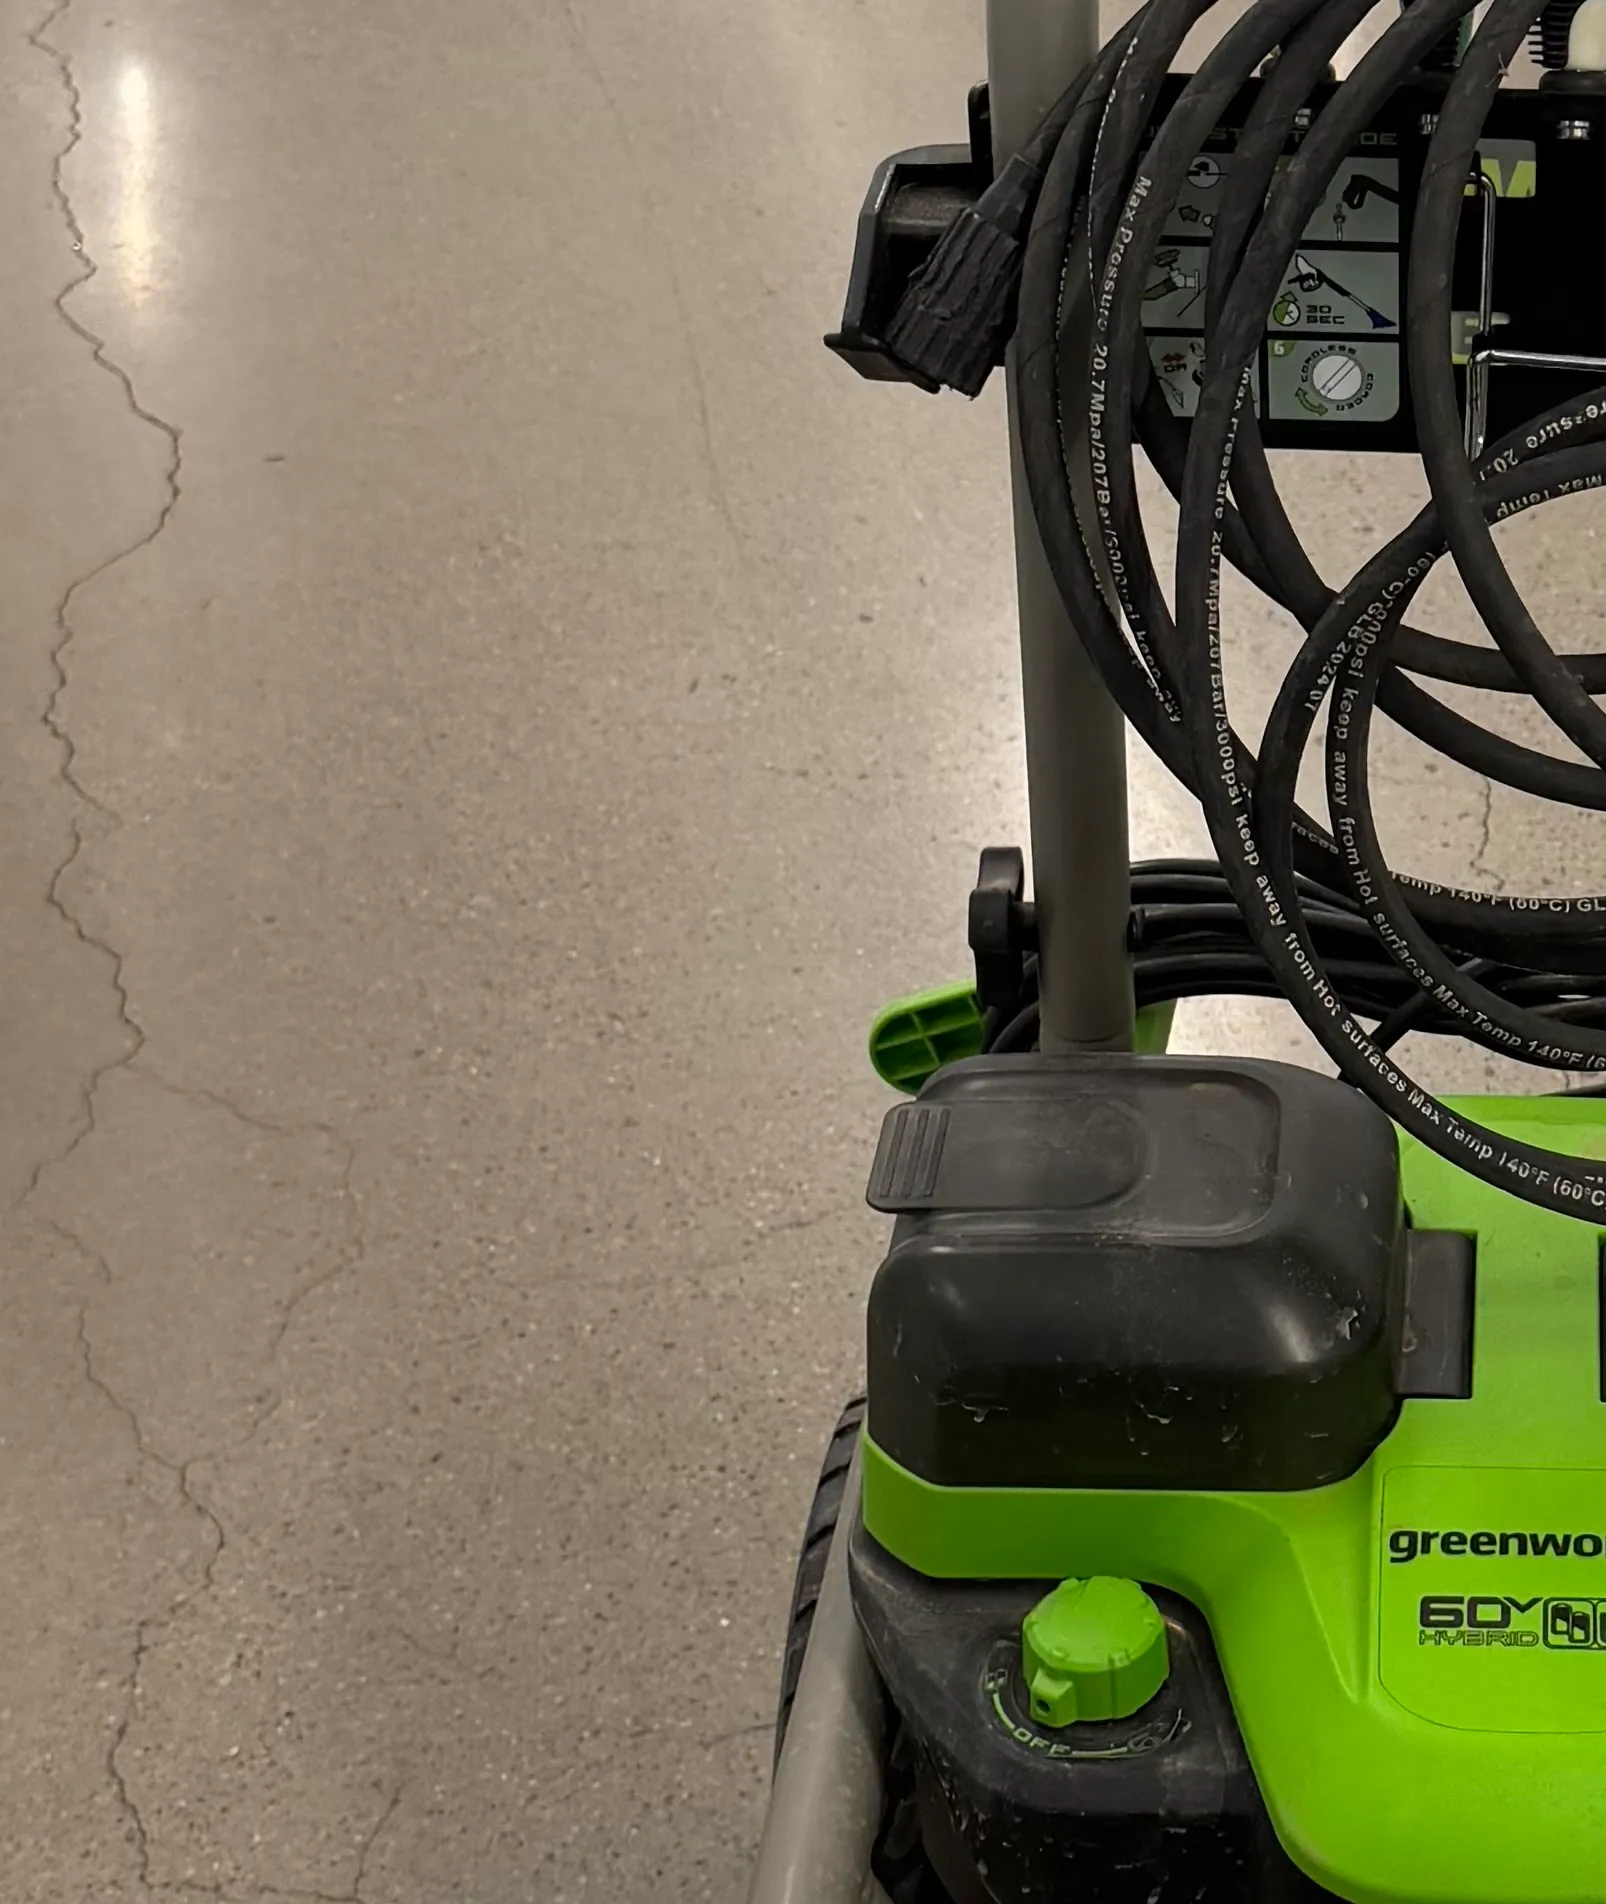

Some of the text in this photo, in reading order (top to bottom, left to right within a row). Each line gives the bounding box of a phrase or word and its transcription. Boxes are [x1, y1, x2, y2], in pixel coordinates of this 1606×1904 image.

[1125, 176, 1152, 222] Max
[1097, 226, 1133, 332] Pressure
[1306, 304, 1332, 314] 30
[1306, 315, 1345, 325] SEC
[1273, 341, 1285, 355] 6
[1301, 343, 1357, 383] CORDLESS
[1336, 372, 1374, 412] CORDED
[1317, 640, 1351, 686] 2024
[1304, 689, 1324, 712] 07
[1333, 687, 1360, 741] keep
[1333, 750, 1348, 807] away
[1339, 817, 1362, 866] from
[1353, 868, 1378, 905] Hot
[1373, 912, 1434, 989] surfaces
[1235, 813, 1261, 866] keep
[1256, 874, 1287, 927] away
[1284, 932, 1317, 981] from
[1312, 978, 1342, 1016] Hot
[1341, 1019, 1407, 1093] surfaces
[1407, 1088, 1440, 1125] Max
[1445, 1116, 1493, 1161] Temp
[1432, 983, 1470, 1018] Max
[1472, 1011, 1521, 1048] Temp
[1419, 1596, 1544, 1629] 60V
[1418, 1630, 1540, 1648] HYBRID
[1013, 1727, 1072, 1756] OFF
